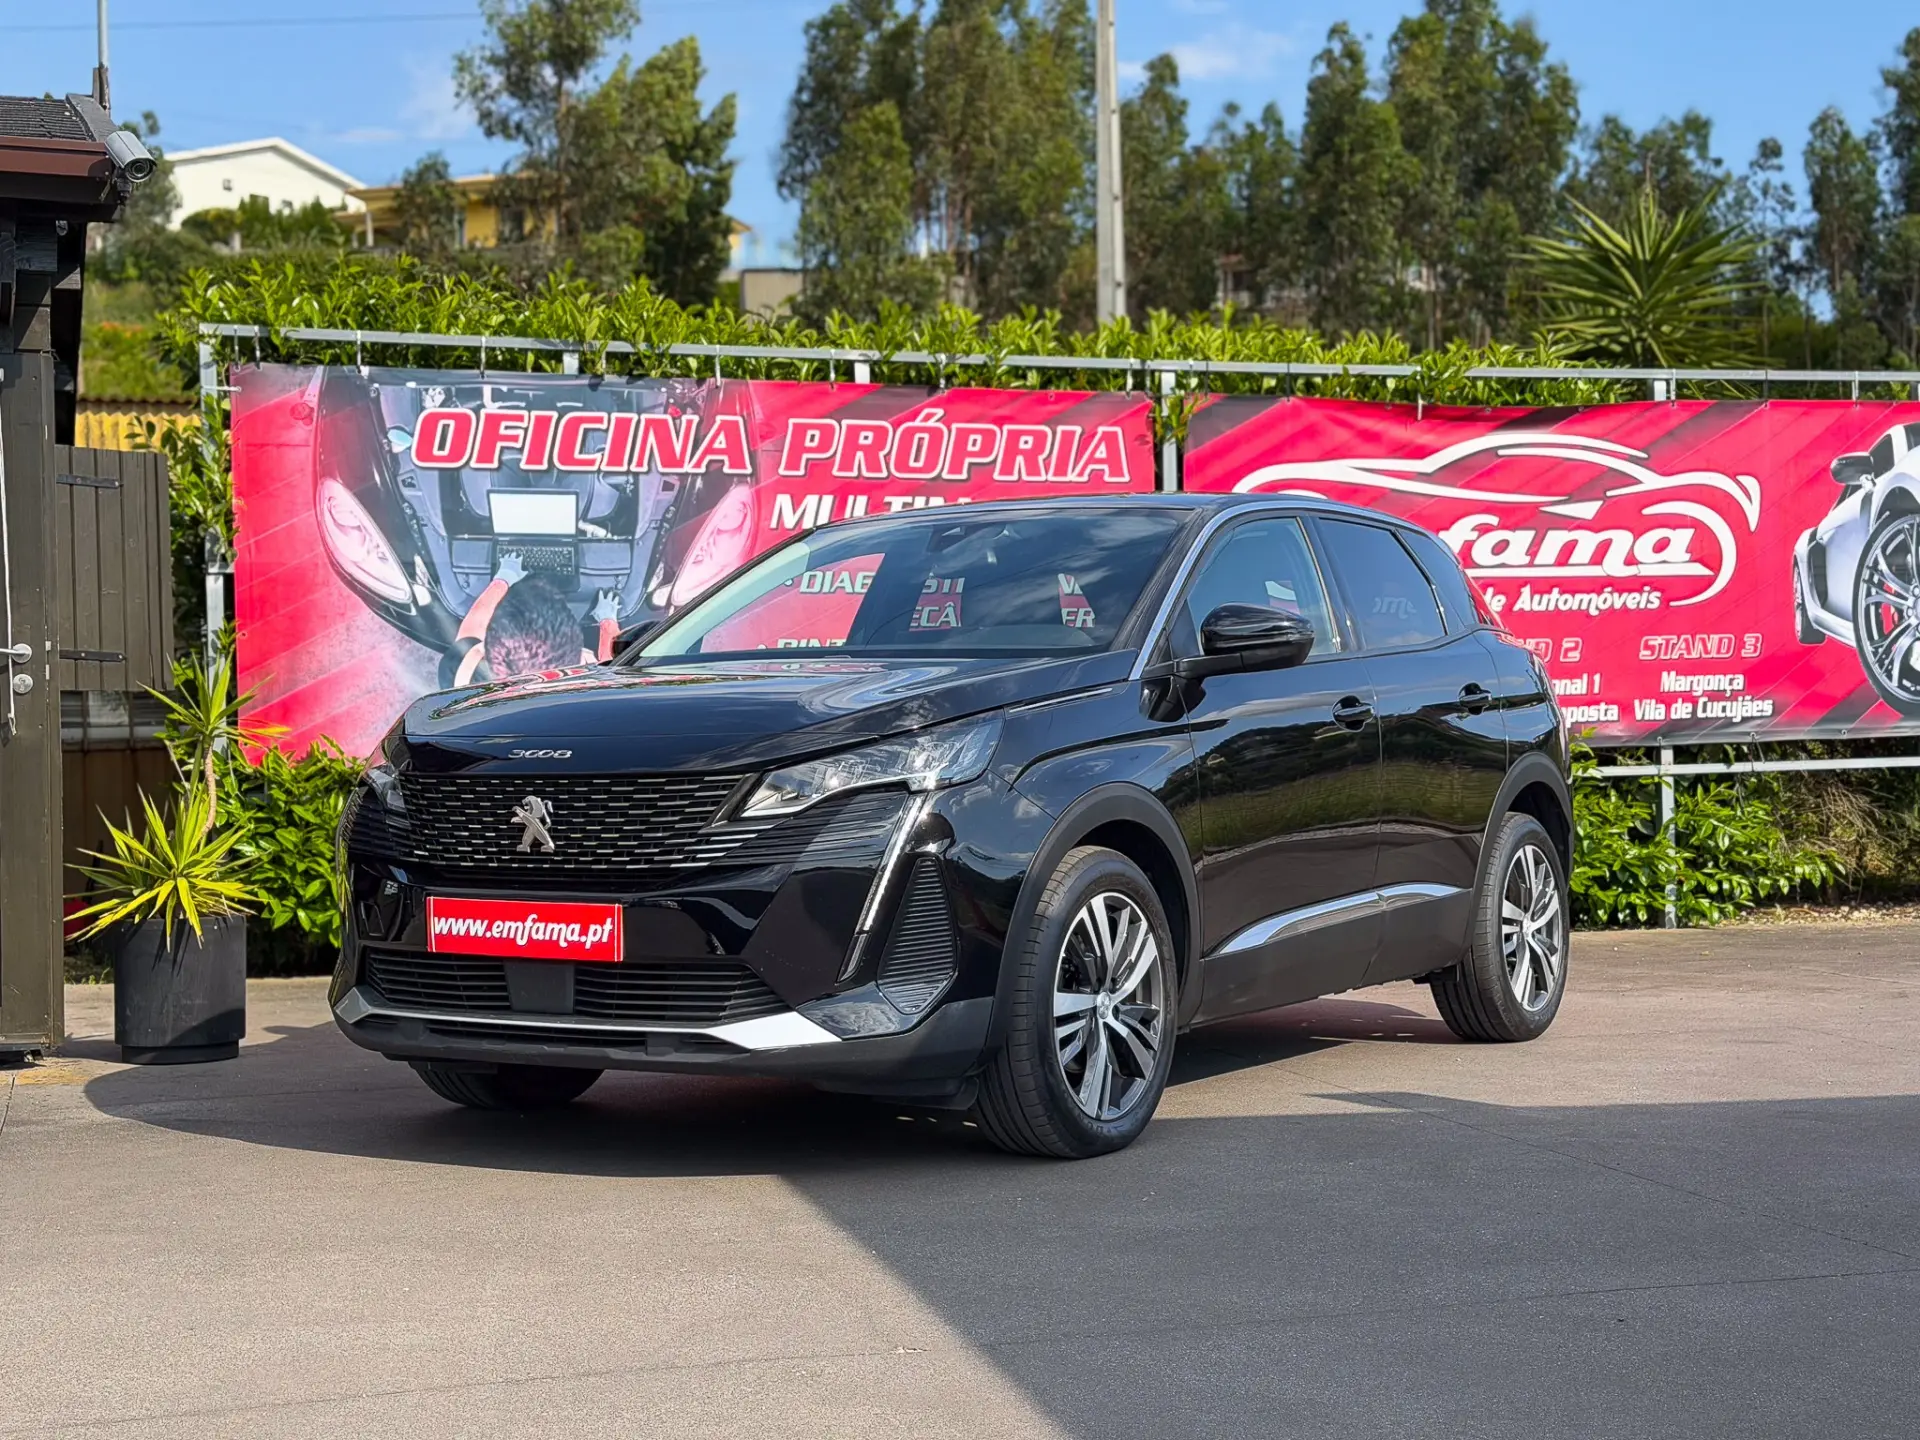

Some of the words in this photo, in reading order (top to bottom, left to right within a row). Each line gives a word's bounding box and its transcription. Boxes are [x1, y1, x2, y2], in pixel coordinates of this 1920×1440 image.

[411, 409, 753, 475] OFICINA
[778, 408, 1132, 483] PRÓPRIA
[1513, 583, 1663, 616] Automóveis
[1560, 637, 1582, 662] 2
[1639, 634, 1735, 660] STAND
[1741, 633, 1762, 658] 3
[1593, 673, 1601, 694] 1
[1660, 670, 1744, 696] Margonça
[1634, 698, 1666, 721] Vila
[1670, 698, 1691, 720] de
[1697, 697, 1774, 722] Cucujães
[508, 749, 573, 759] 3008
[433, 913, 614, 949] www.emfama.pt
